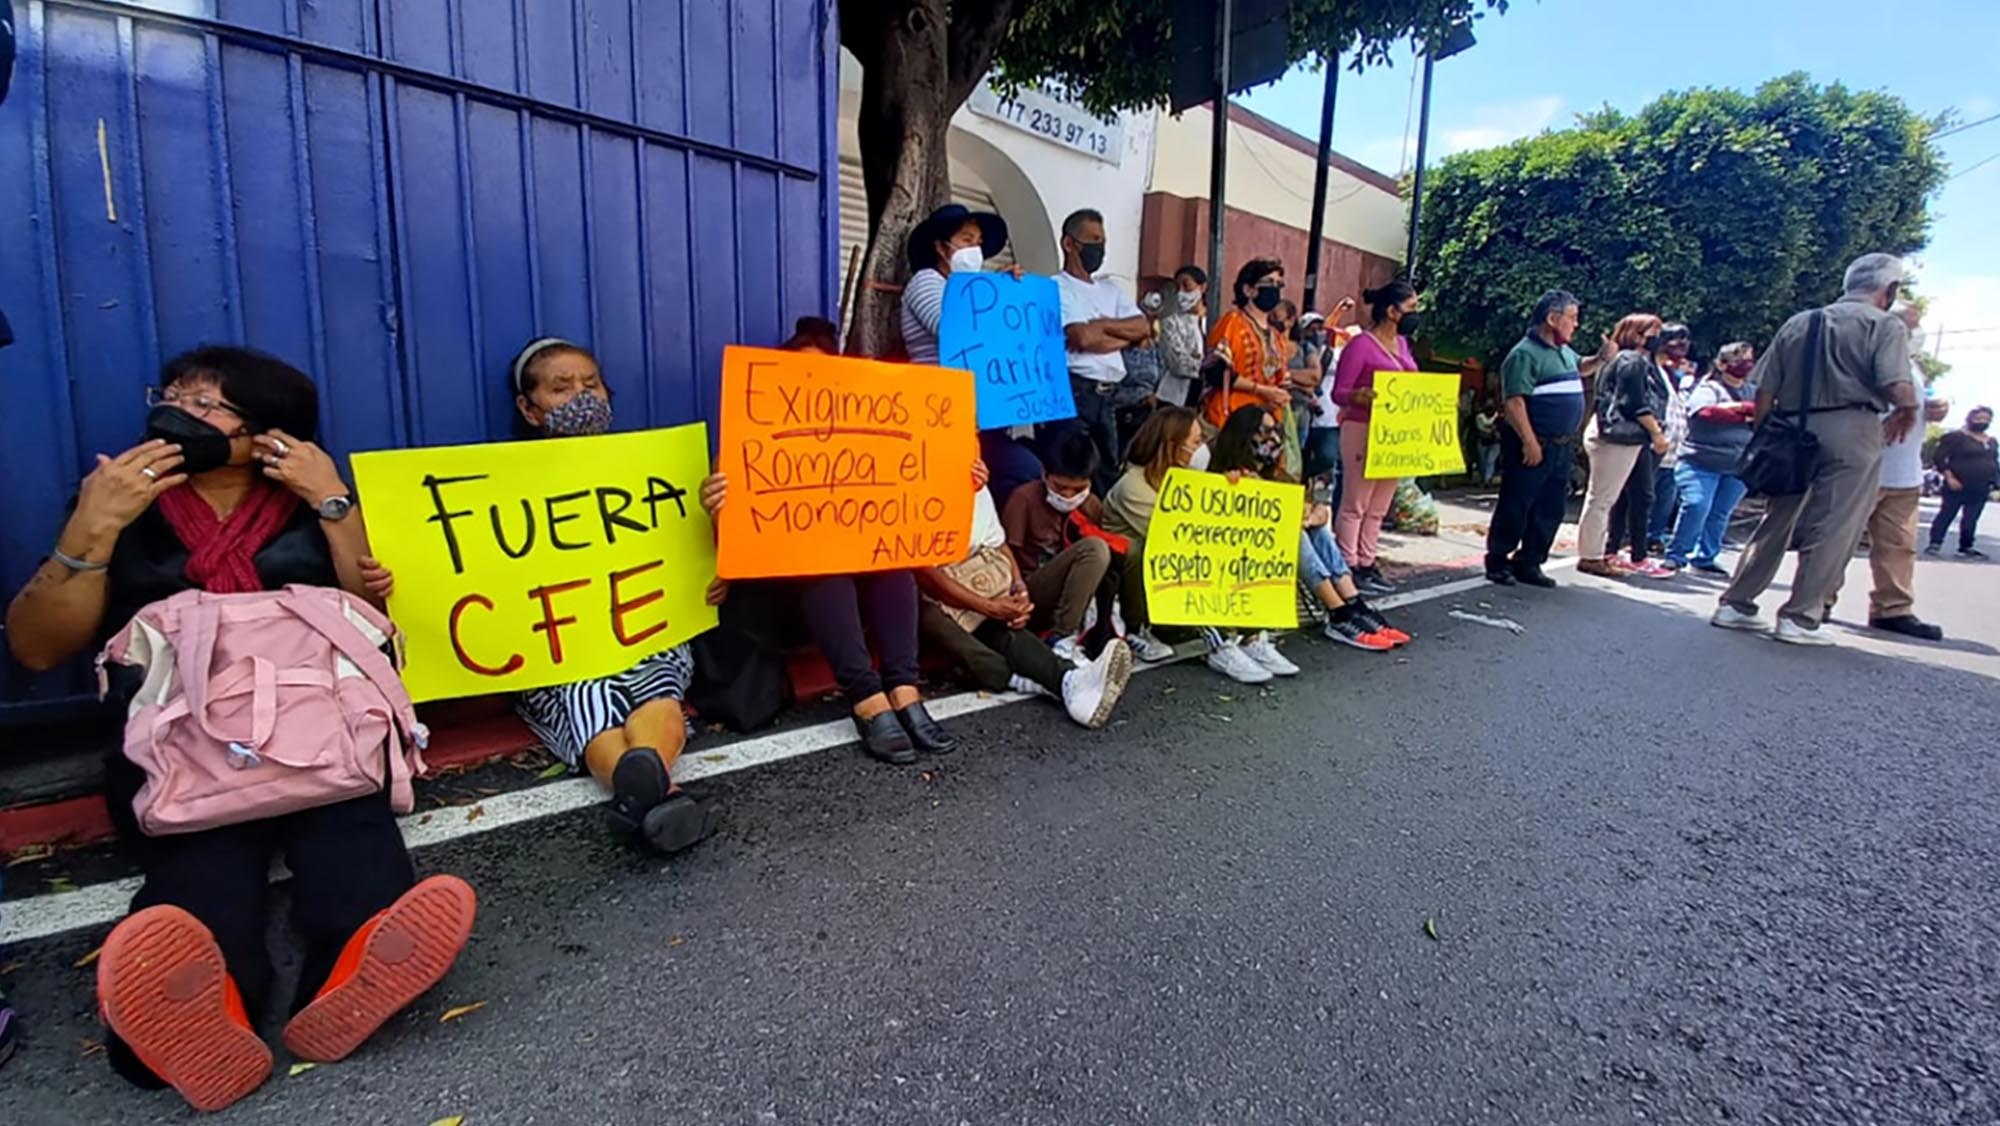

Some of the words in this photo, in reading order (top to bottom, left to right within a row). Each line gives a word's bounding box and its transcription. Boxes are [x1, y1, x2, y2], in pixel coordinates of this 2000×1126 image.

[1029, 108, 1062, 138] 233
[1065, 121, 1084, 146] 97
[1087, 131, 1108, 154] 13
[961, 276, 1036, 333] Por
[746, 362, 909, 442] Exigimos
[925, 393, 953, 428] se
[1385, 377, 1443, 415] Somos
[1430, 419, 1453, 447] NO
[742, 439, 877, 494] Rompa
[900, 440, 927, 481] el
[1159, 475, 1193, 513] Los
[422, 474, 687, 574] FUERA
[1174, 522, 1275, 550] merecemos
[872, 531, 959, 565] ANUEE
[1150, 551, 1212, 586] respeto
[1229, 549, 1294, 584] atención
[450, 559, 669, 677] CFE
[1185, 591, 1252, 617] ANUEE
